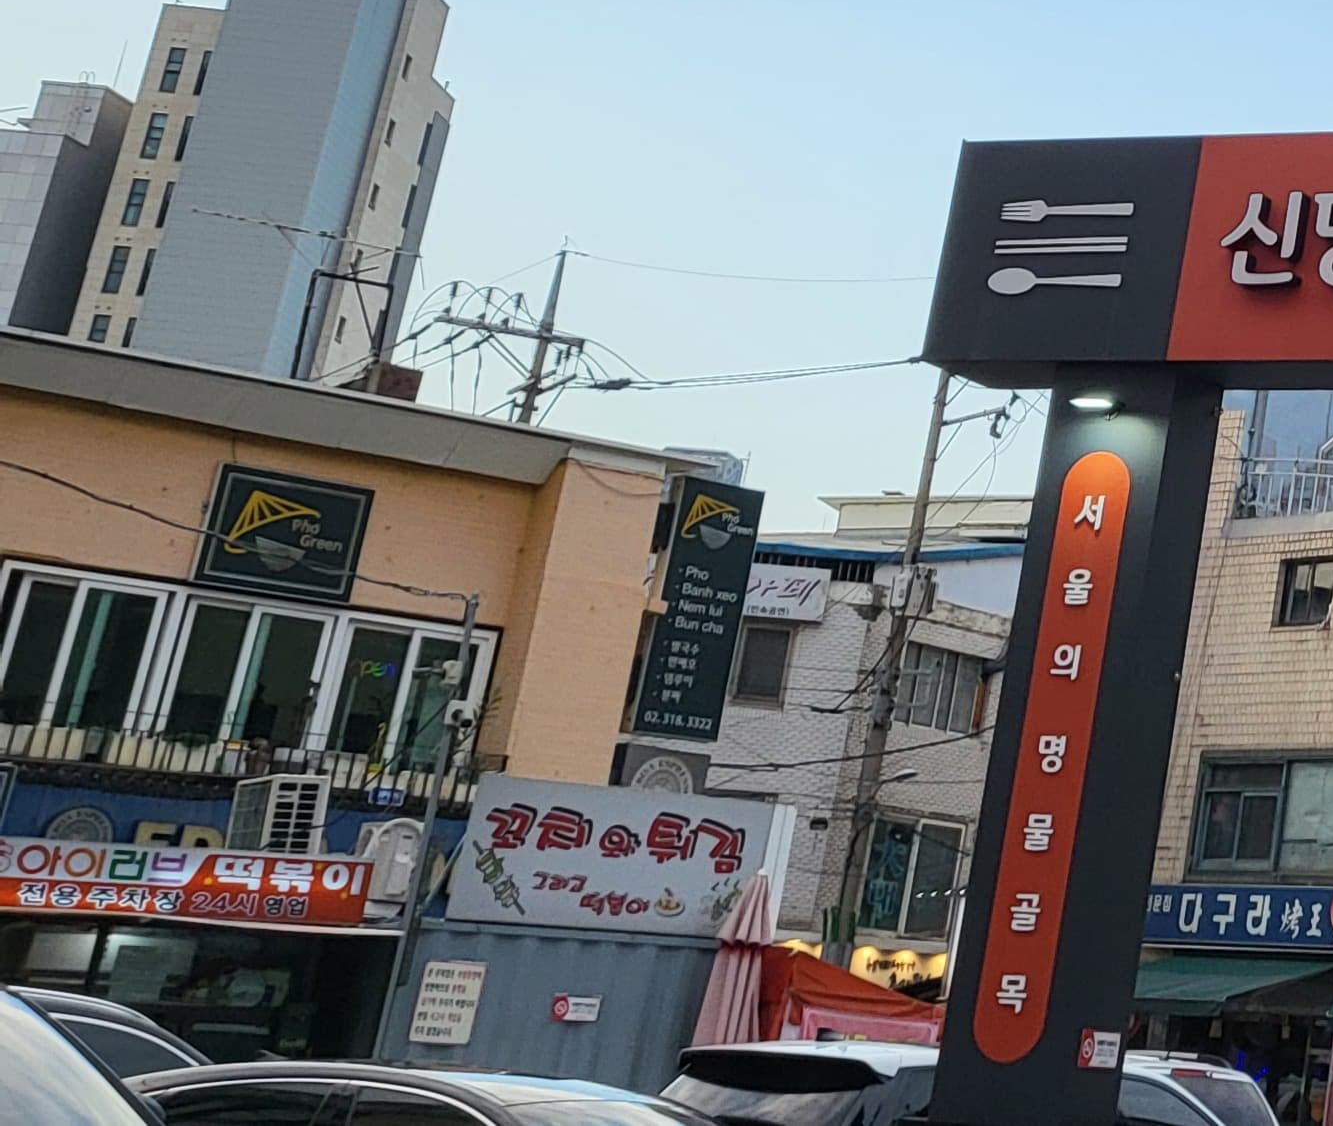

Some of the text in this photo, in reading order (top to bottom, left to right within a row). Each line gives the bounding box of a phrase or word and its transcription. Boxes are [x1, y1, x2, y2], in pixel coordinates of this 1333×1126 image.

[292, 519, 320, 535] Pho
[727, 523, 753, 536] Green
[300, 534, 343, 553] Green
[685, 565, 709, 580] Pho
[681, 582, 713, 598] Banh
[715, 590, 737, 603] xeo
[678, 599, 706, 614] Nem
[674, 616, 724, 635] Bun cha
[17, 844, 364, 897] 아이러브 떡볶이
[190, 892, 258, 916] 24시
[263, 895, 307, 919] 영업
[1179, 893, 1272, 936] 다구라
